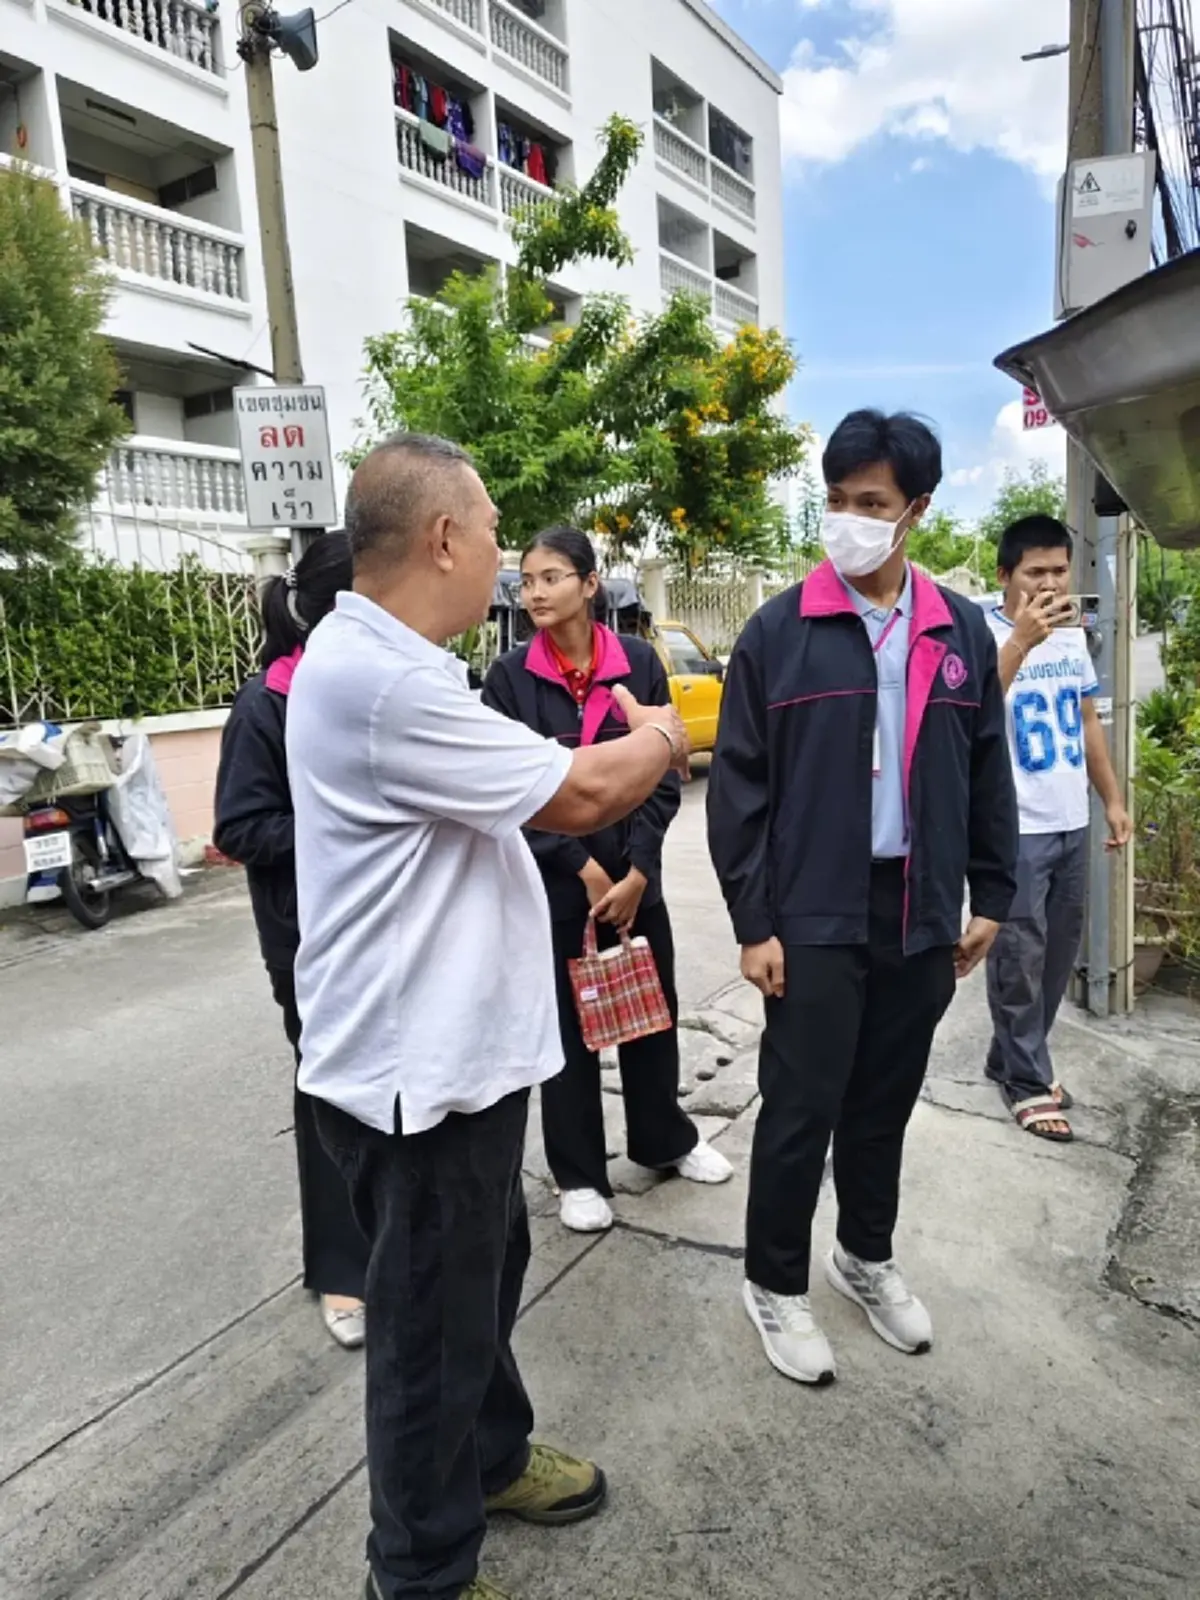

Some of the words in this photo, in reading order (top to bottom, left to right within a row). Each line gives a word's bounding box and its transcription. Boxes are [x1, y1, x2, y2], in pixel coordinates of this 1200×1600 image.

[238, 394, 322, 419] เขตชุมชน
[1023, 408, 1048, 429] 09
[258, 424, 305, 448] ลด
[251, 459, 323, 481] ความ
[271, 487, 314, 520] เร็ว
[1013, 686, 1083, 773] 69
